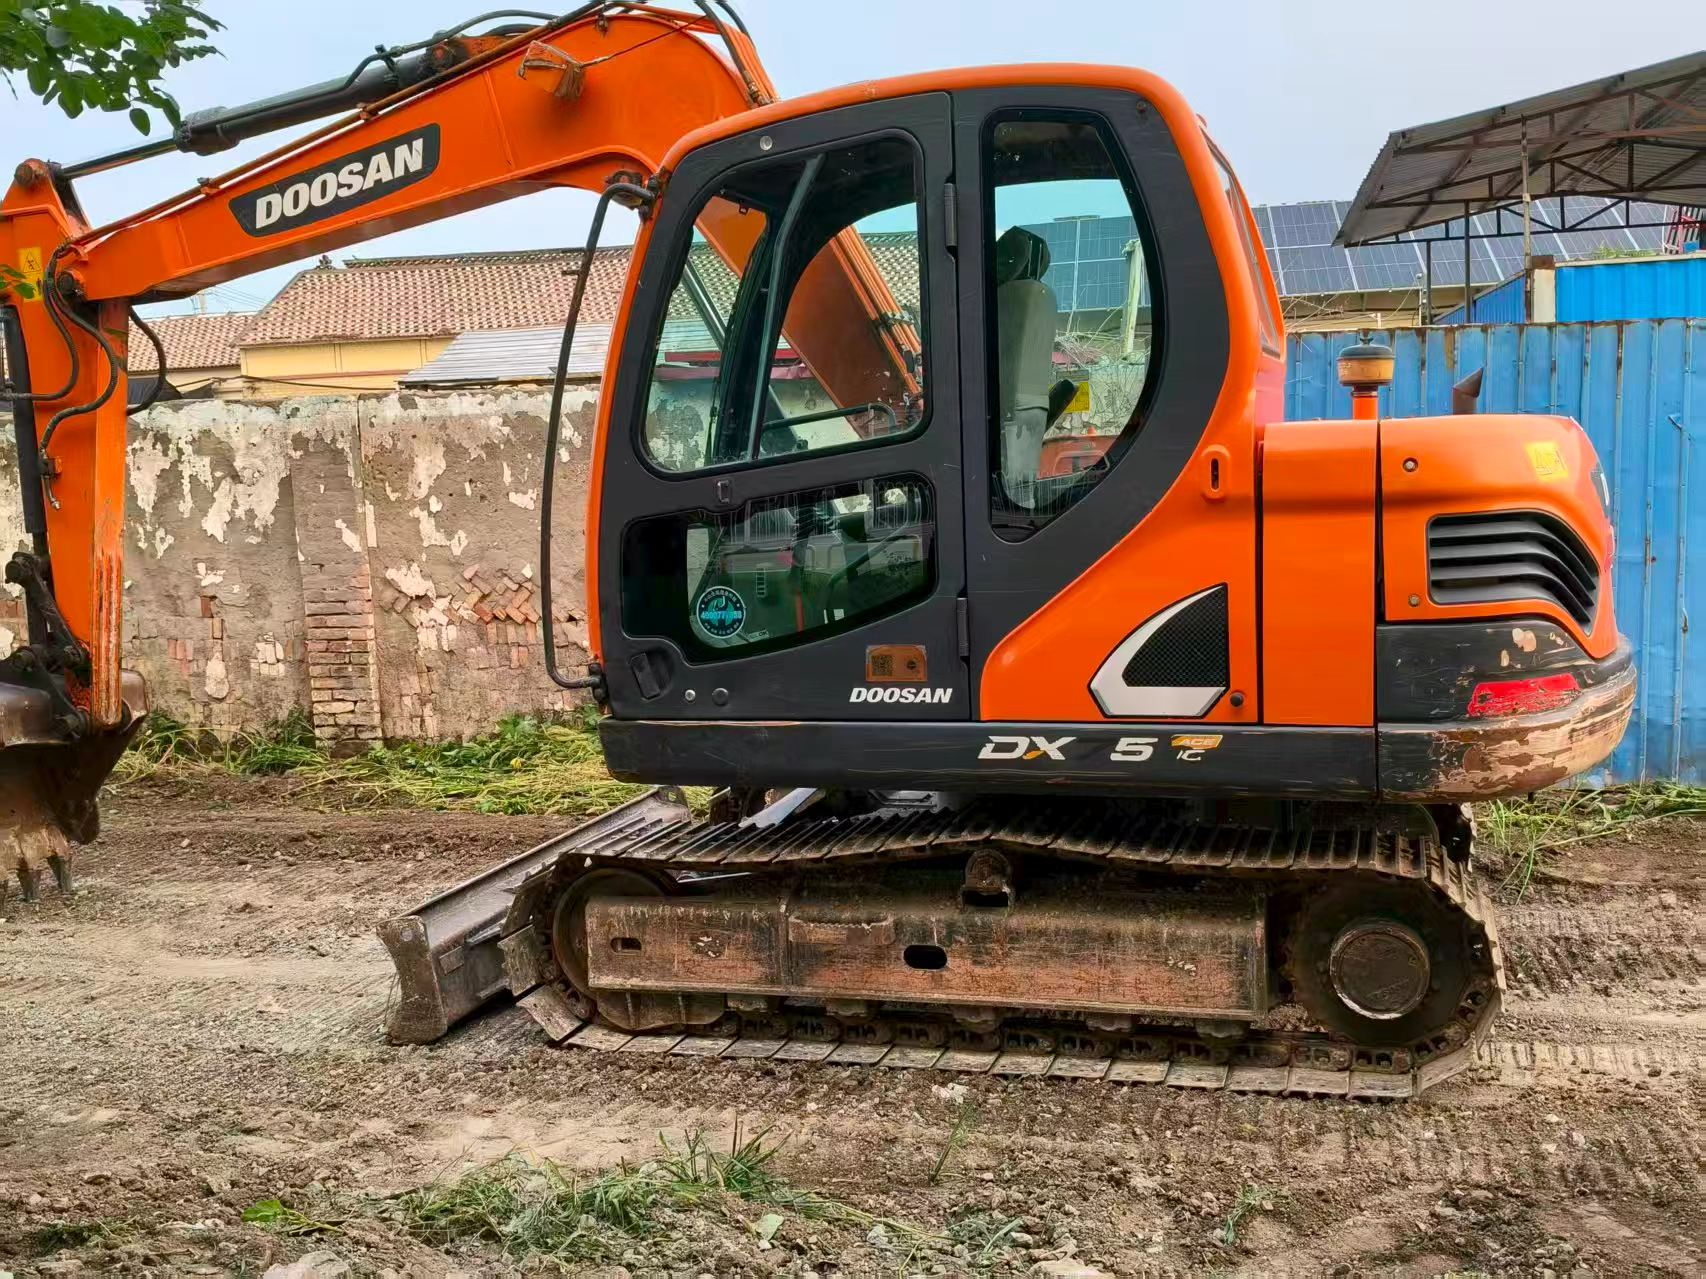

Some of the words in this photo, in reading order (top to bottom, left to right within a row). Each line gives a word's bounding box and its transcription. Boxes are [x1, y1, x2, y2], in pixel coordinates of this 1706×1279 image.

[255, 138, 424, 229] DOOSAN
[849, 687, 953, 703] DOOSAN
[977, 735, 1077, 760] DX
[1110, 737, 1159, 761] 5
[1182, 738, 1217, 747] ACE
